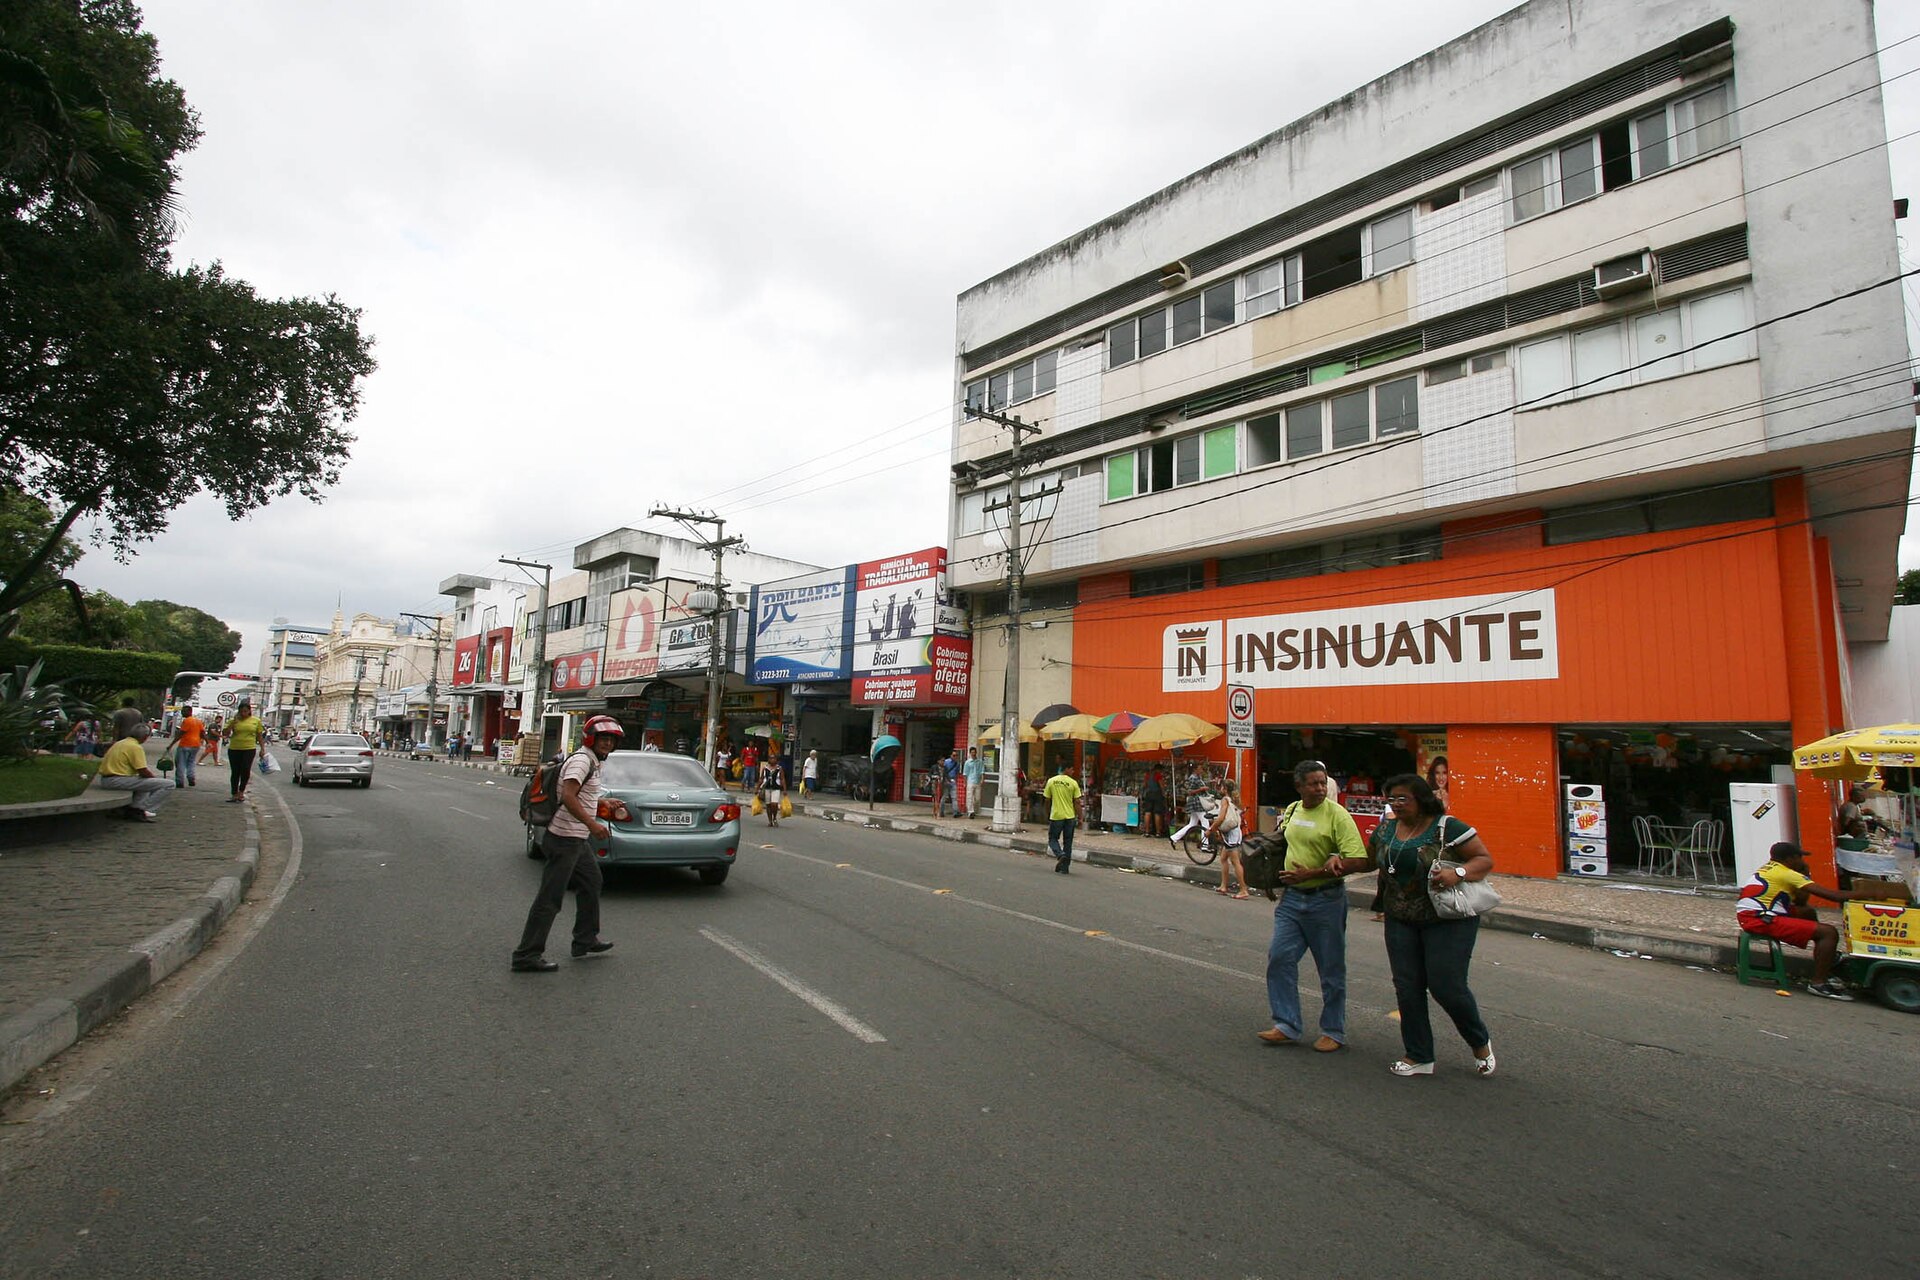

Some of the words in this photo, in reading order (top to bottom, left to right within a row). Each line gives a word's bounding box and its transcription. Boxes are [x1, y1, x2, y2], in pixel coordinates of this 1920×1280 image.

[864, 562, 929, 587] TRABALHADOR
[1235, 610, 1543, 674] INSINUANTE
[873, 650, 899, 666] Brasil
[936, 646, 968, 660] Cobrimos
[936, 657, 967, 670] qualquer
[1178, 646, 1207, 677] IN
[761, 669, 790, 680] 3223-3772
[935, 667, 967, 684] oferta
[865, 680, 891, 690] Cobrimos
[891, 678, 917, 689] qualquer
[934, 682, 944, 692] do
[945, 683, 967, 695] Brasil
[221, 694, 233, 702] 50
[864, 690, 884, 700] oferta
[895, 687, 916, 699] Brasil
[1869, 918, 1908, 929] Bahia
[1871, 926, 1908, 938] Sorte
